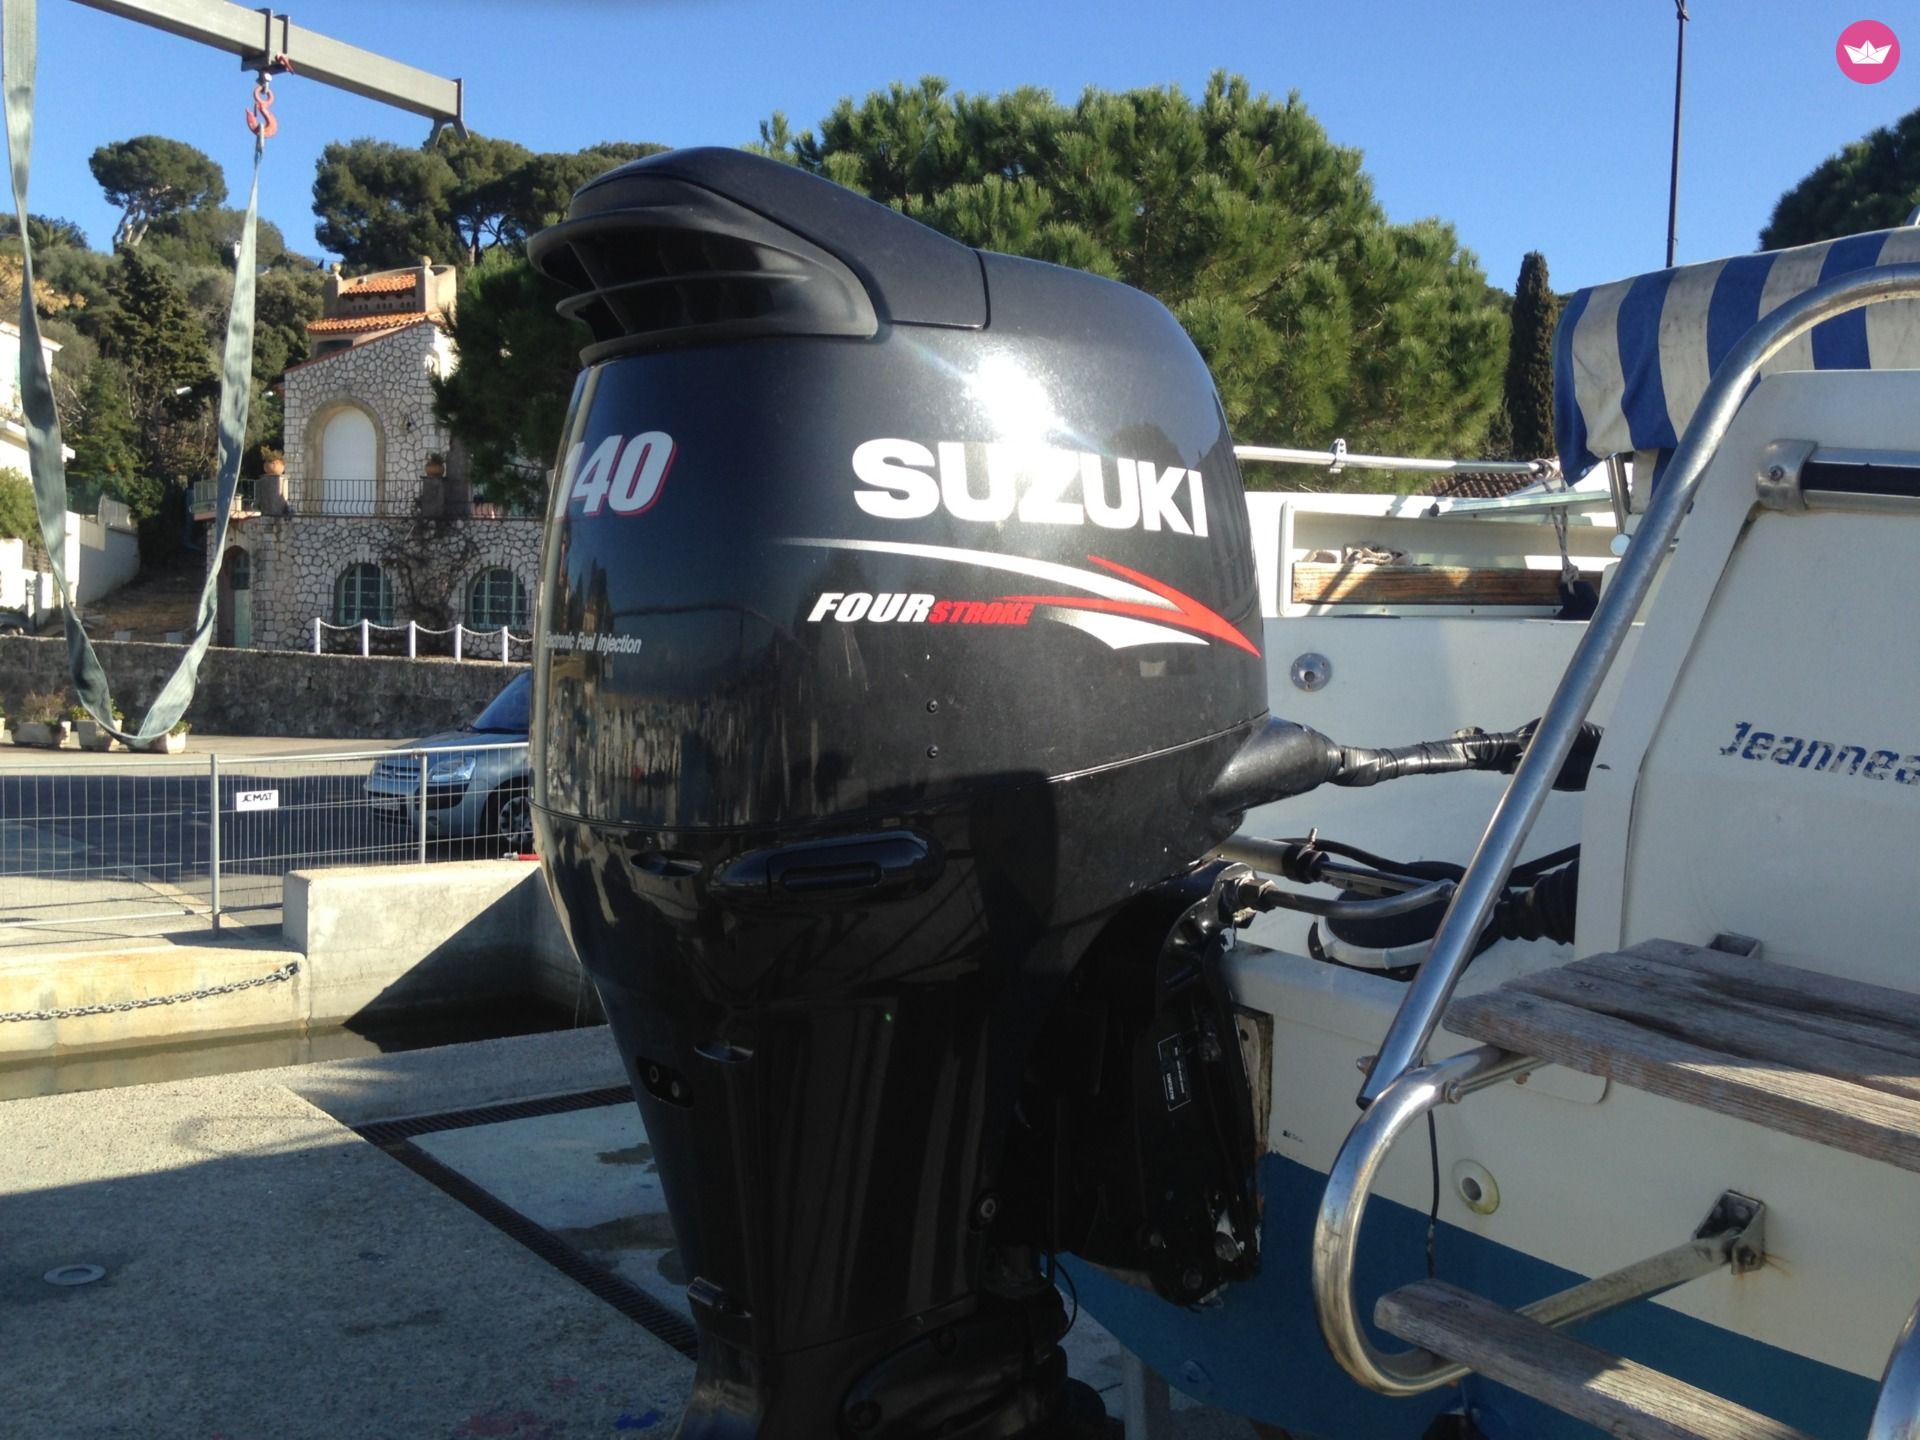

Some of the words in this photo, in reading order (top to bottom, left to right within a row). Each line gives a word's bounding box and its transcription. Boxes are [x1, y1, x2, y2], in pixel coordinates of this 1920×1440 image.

[553, 431, 677, 520] 140
[852, 438, 1209, 537] SUZUKI
[576, 631, 597, 651] Fuel
[597, 632, 642, 656] Injection
